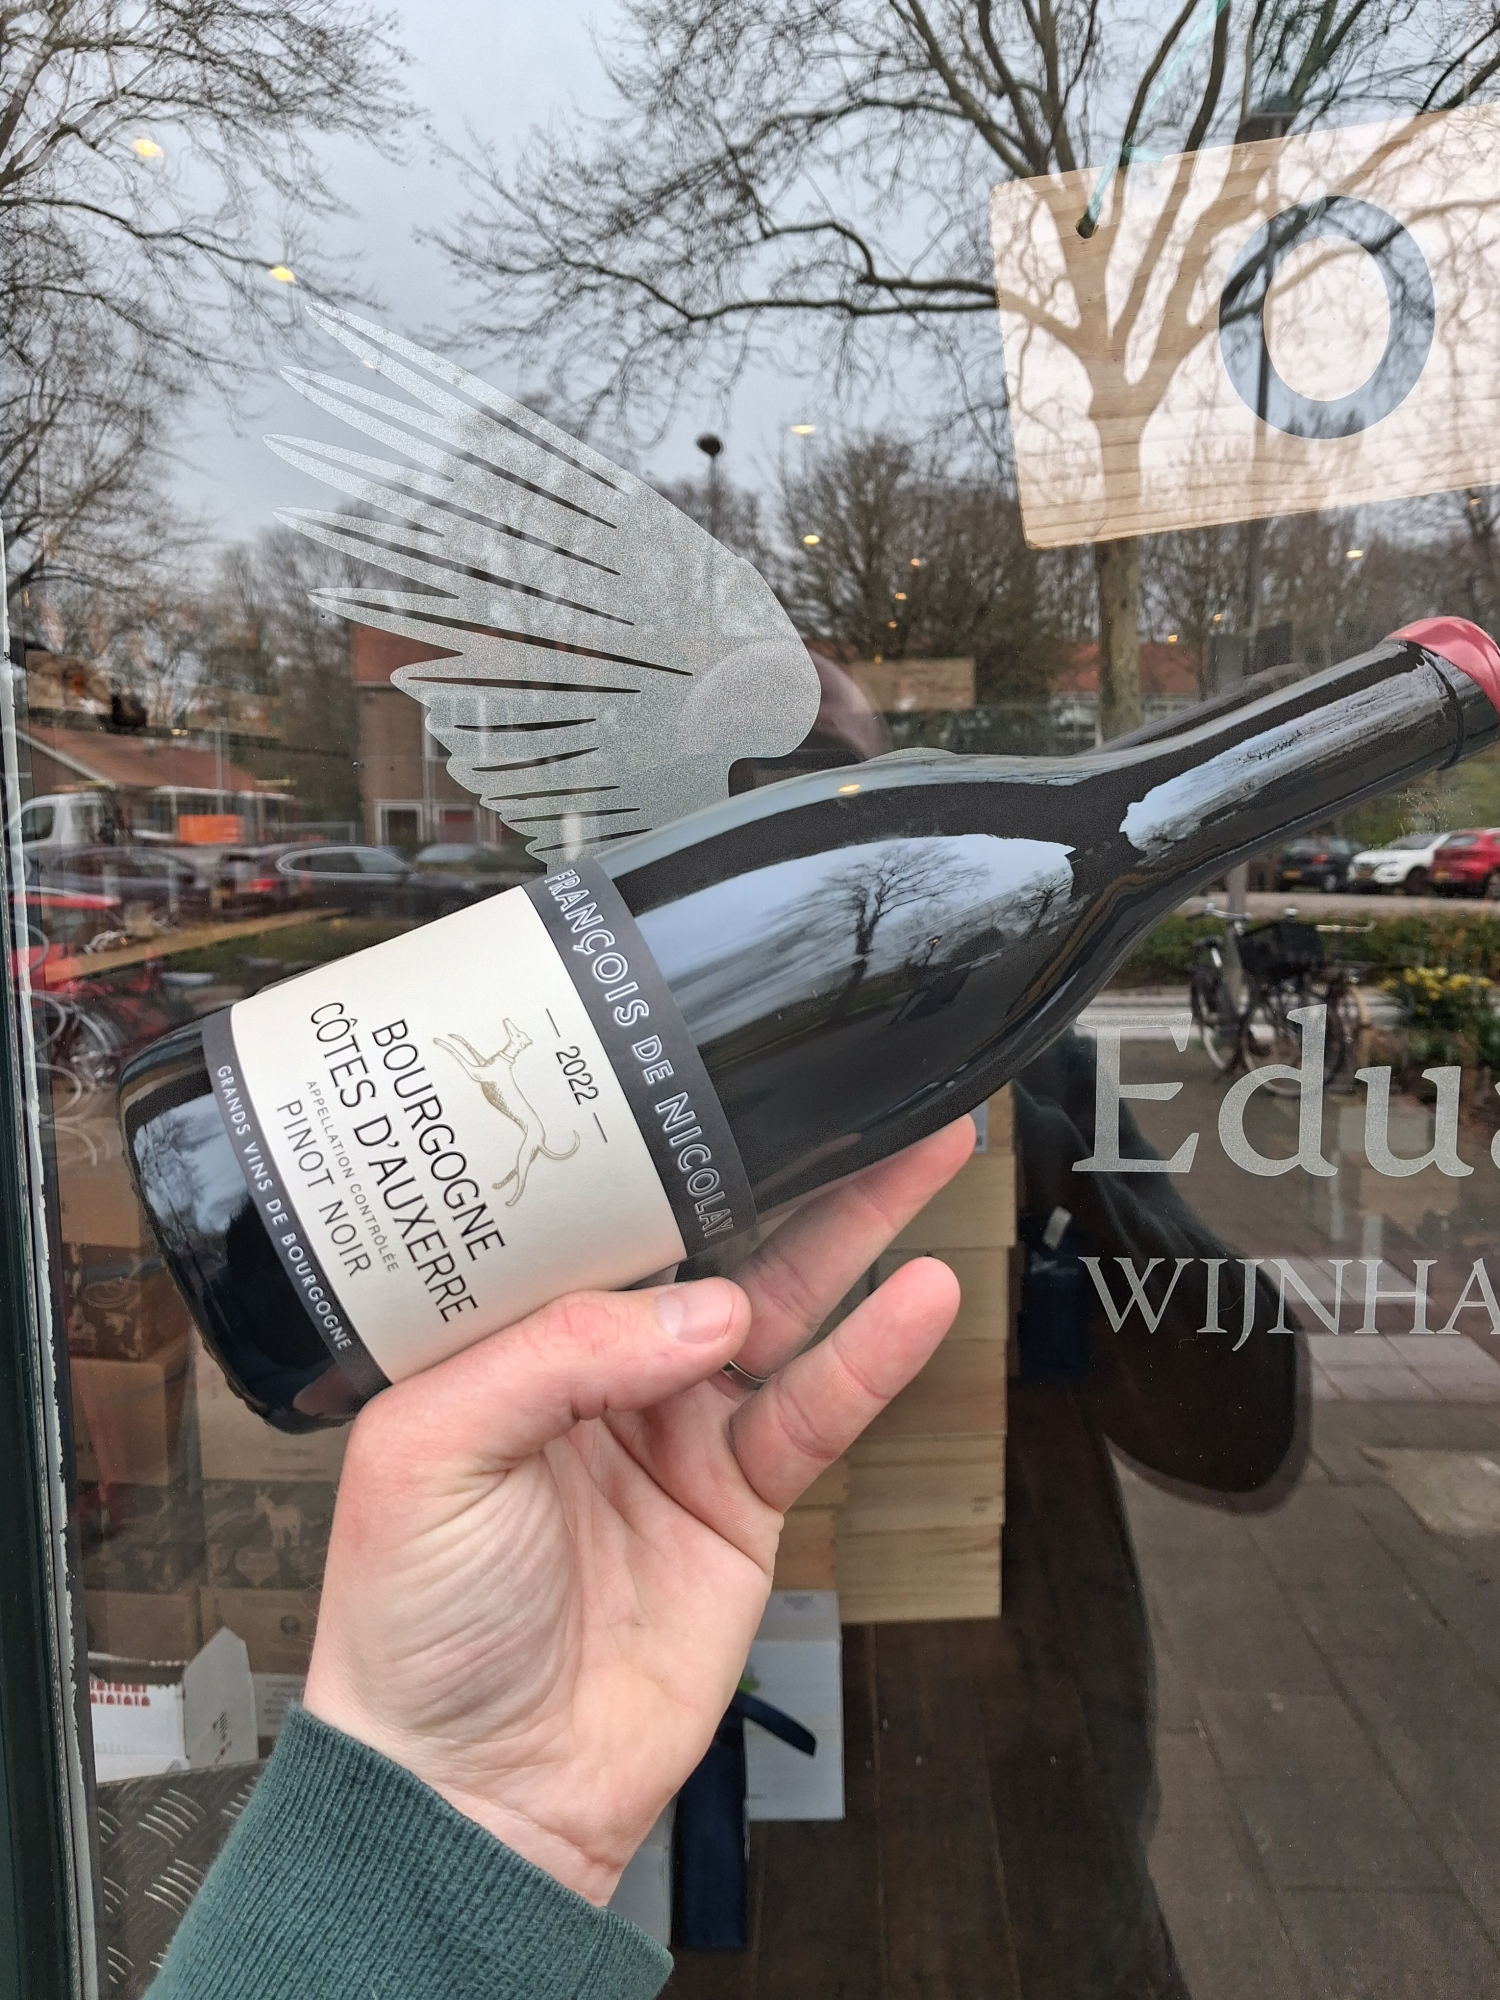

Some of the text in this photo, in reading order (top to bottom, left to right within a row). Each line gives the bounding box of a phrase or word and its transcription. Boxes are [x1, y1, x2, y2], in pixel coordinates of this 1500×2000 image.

[1218, 195, 1436, 440] O
[371, 1018, 506, 1261] BOURGOGNE
[543, 867, 734, 1238] FRANÇOIS DE NICOLAY
[555, 1045, 600, 1105] 2022
[1071, 1003, 1500, 1177] Edu
[216, 1065, 352, 1350] GRANDS VINS DE BOURGOGNE
[276, 1099, 372, 1277] PINOT NOIR
[306, 1080, 400, 1273] APPELLATION CONTRÔLÉE
[310, 1002, 479, 1323] CÔTES D'AUXERRE
[1078, 1256, 1500, 1352] WIJNHA
